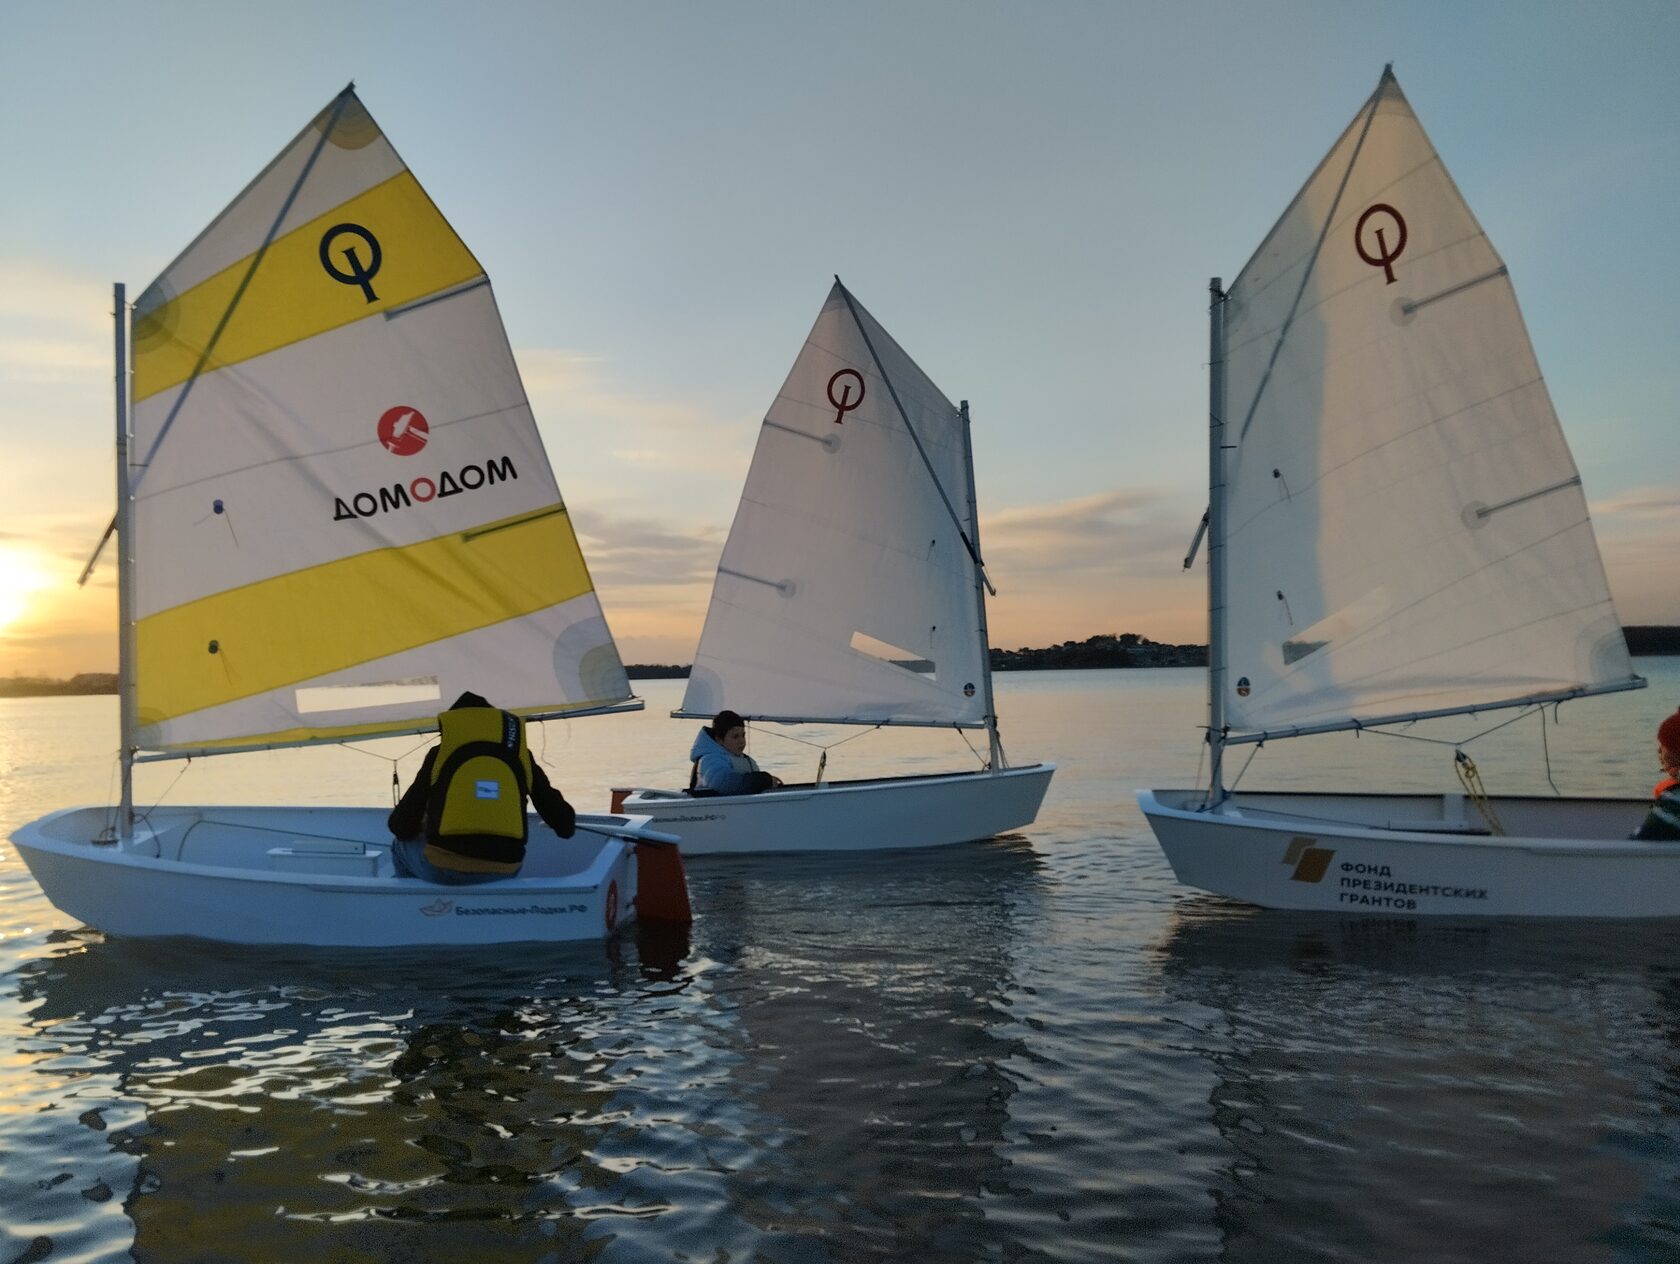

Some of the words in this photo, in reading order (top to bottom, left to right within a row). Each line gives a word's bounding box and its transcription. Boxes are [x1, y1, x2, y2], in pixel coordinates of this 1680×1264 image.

[333, 455, 518, 522] ДОМОДОМ
[1340, 862, 1392, 878] ФОНД
[1340, 877, 1489, 900] ПРЕЗИДЕНТСКИХ
[1339, 892, 1418, 910] ГРАНТОВ
